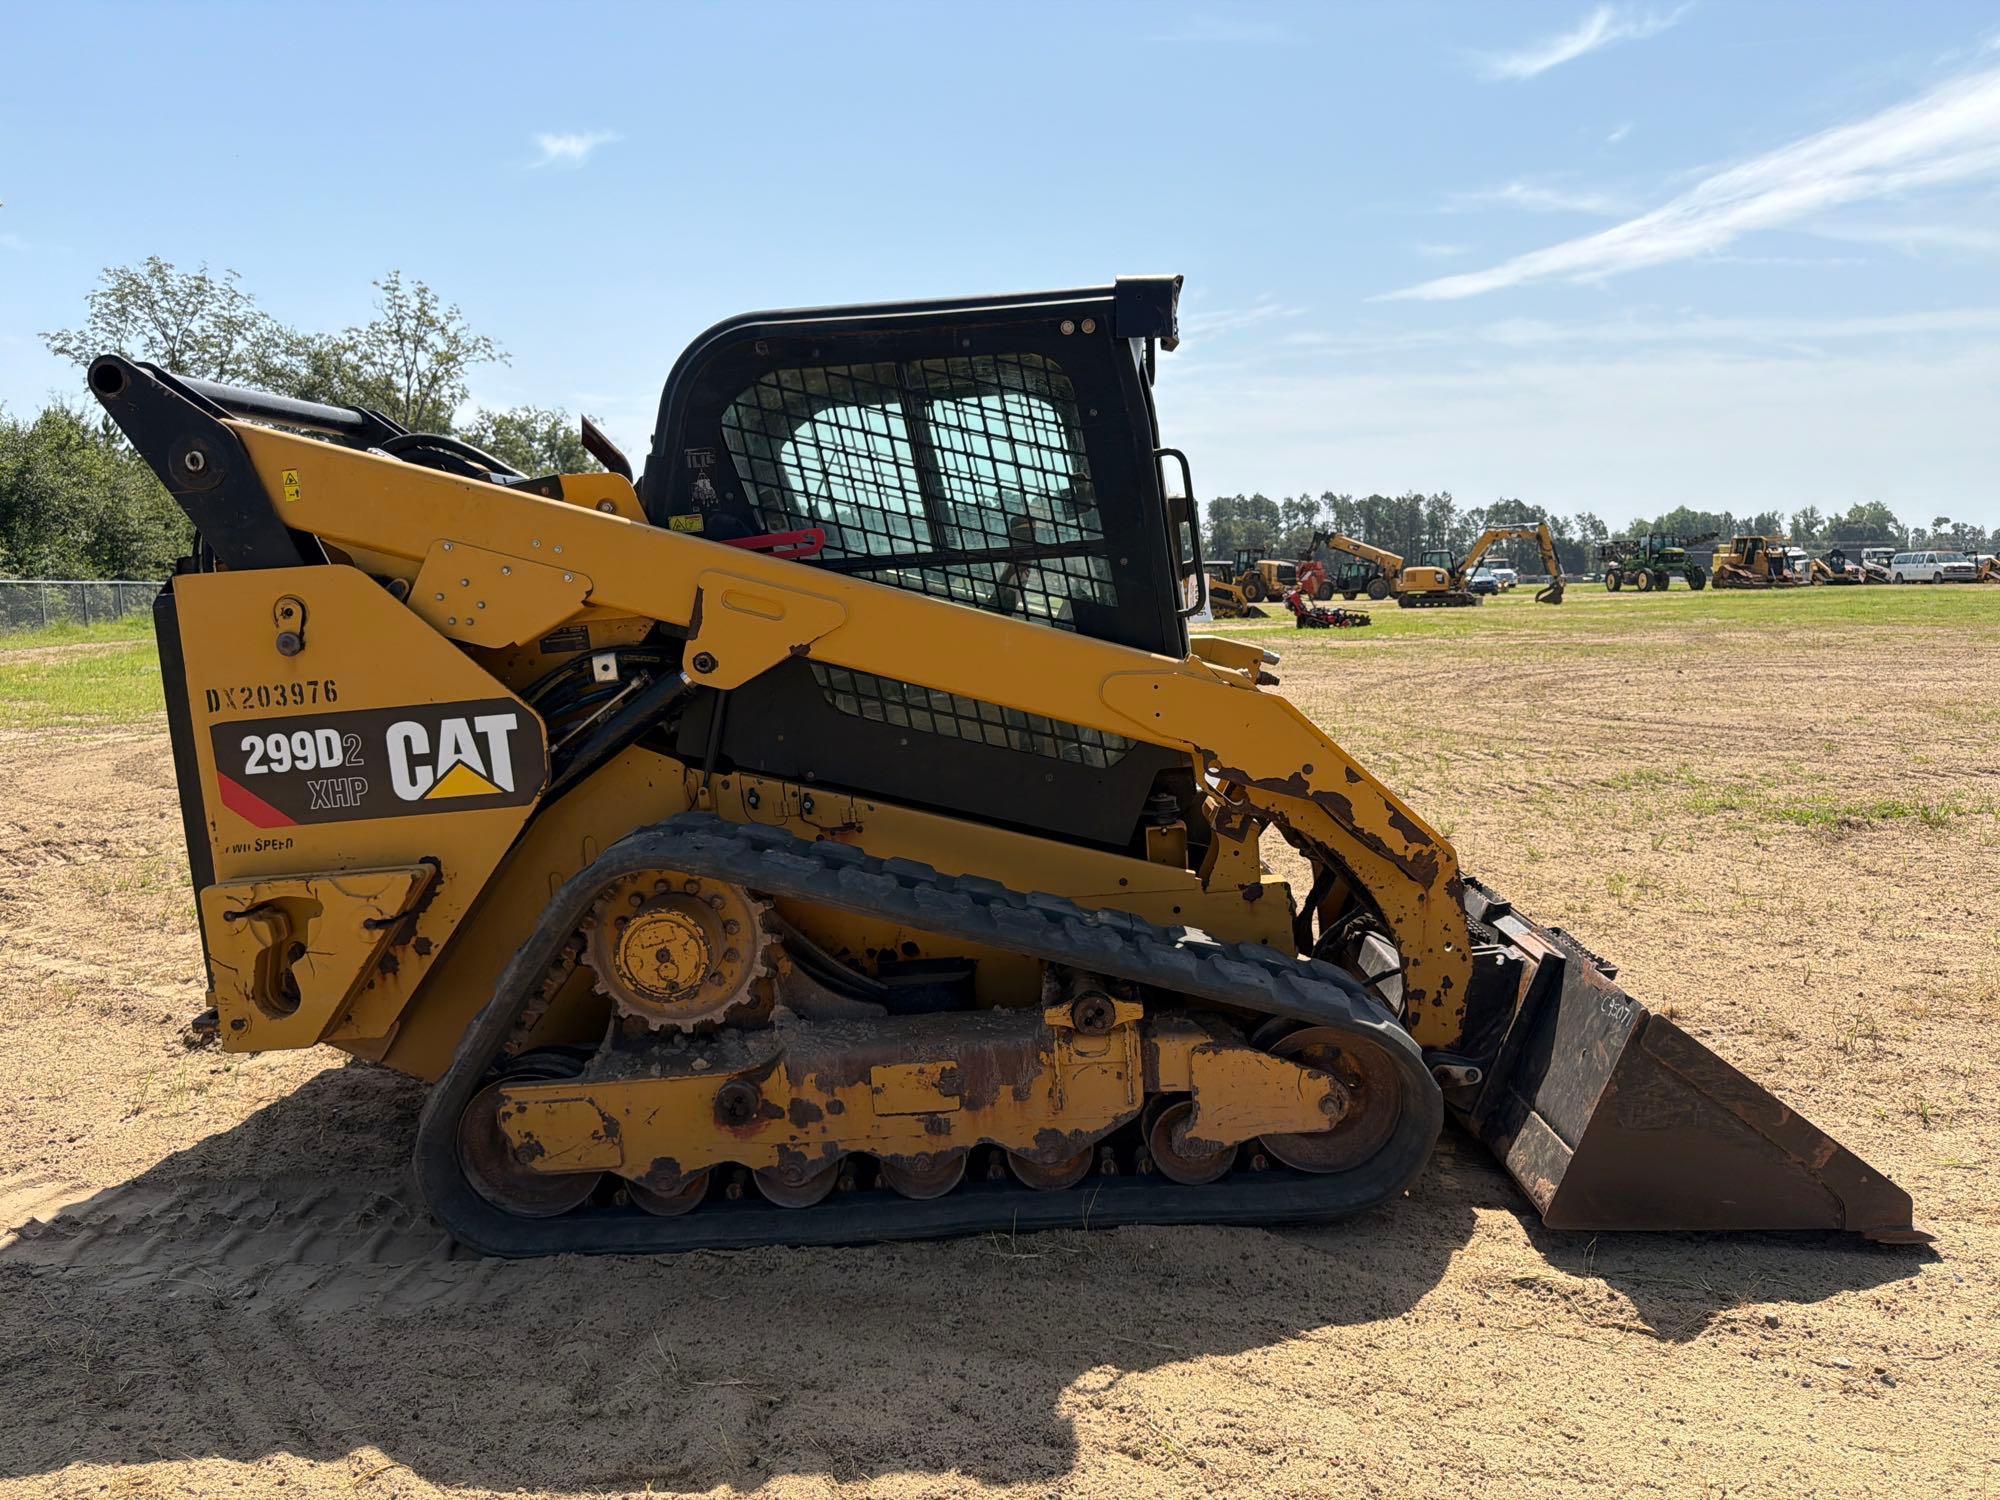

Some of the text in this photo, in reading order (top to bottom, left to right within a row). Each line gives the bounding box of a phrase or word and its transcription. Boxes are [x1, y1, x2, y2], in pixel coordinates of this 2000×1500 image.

[205, 680, 338, 713] DX203976
[241, 728, 364, 775] 299D2
[386, 713, 518, 801] CAT
[307, 776, 369, 810] XHP
